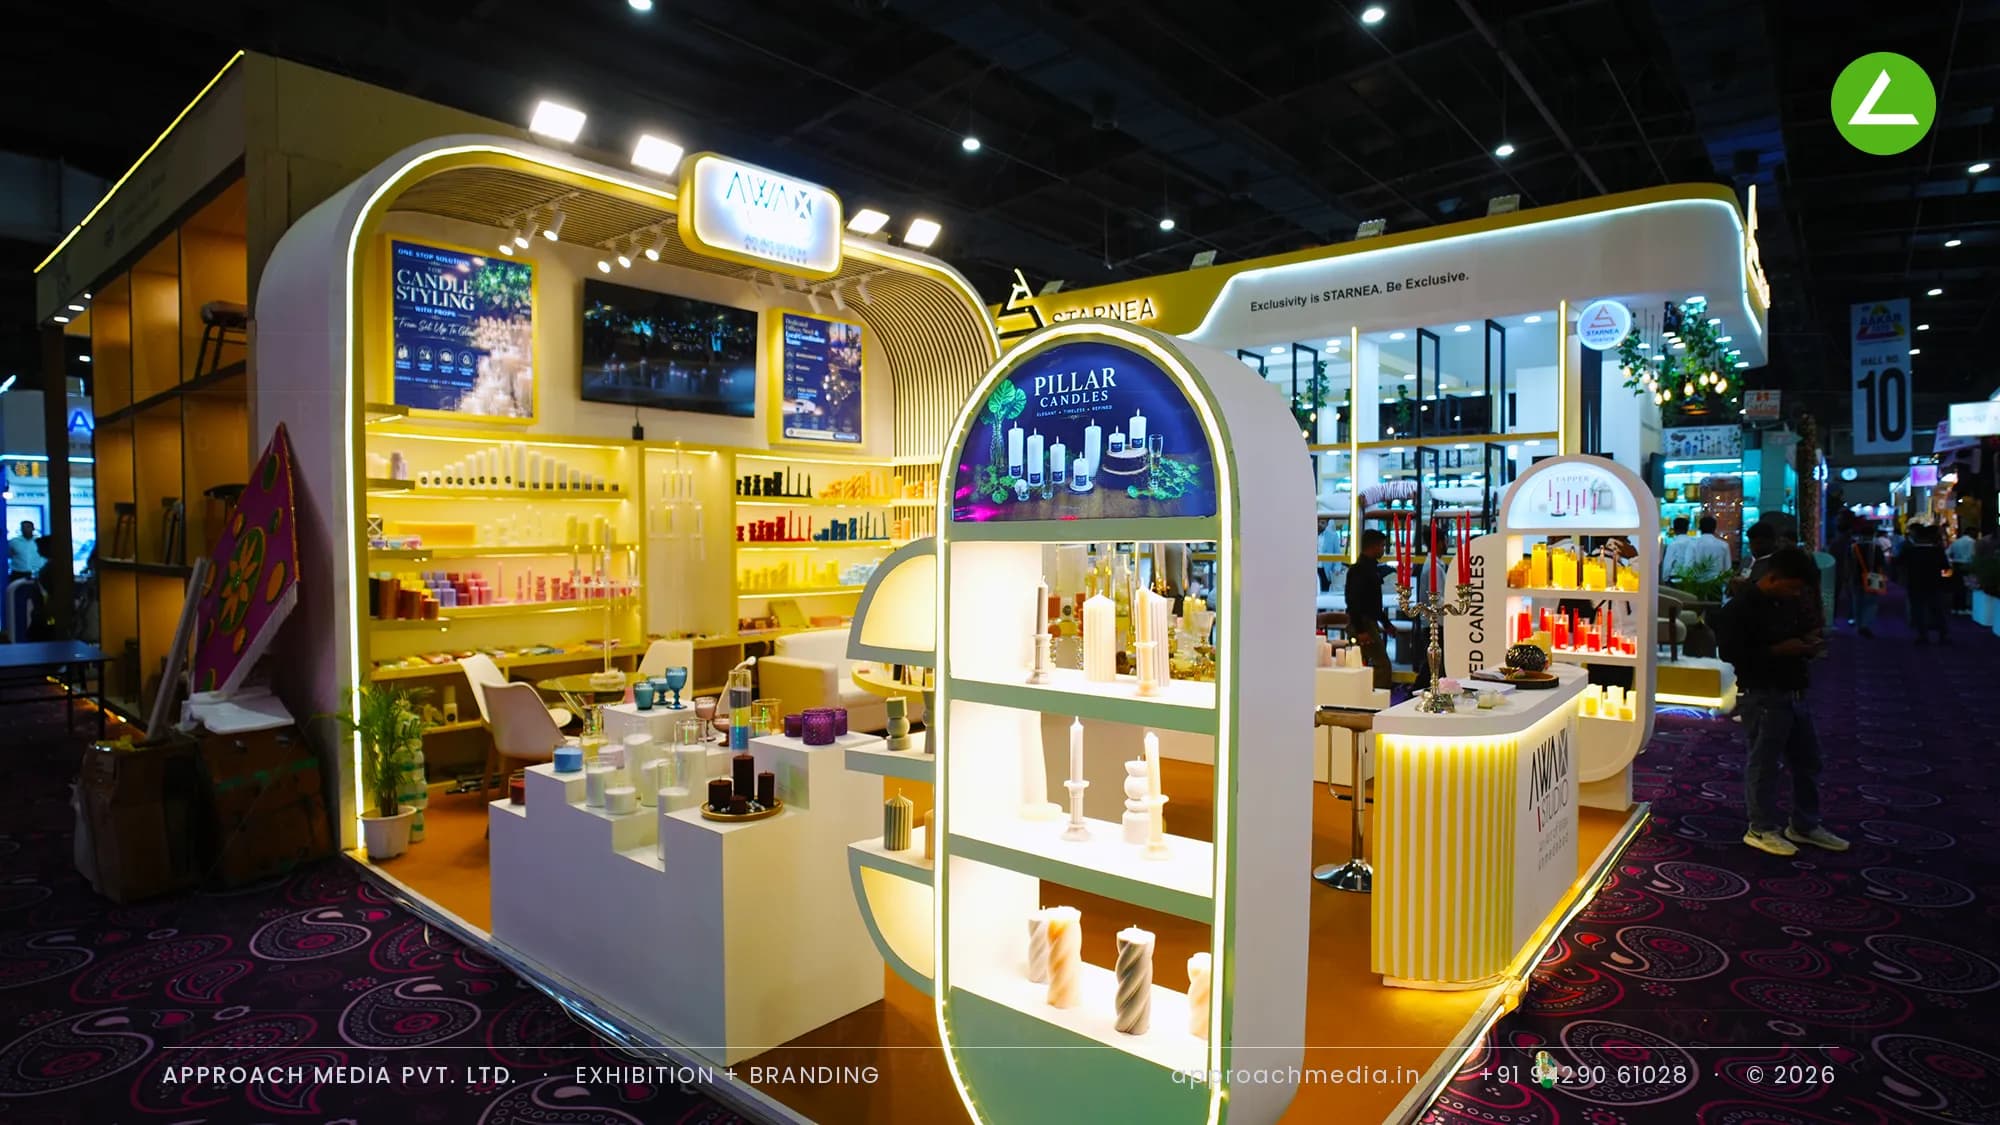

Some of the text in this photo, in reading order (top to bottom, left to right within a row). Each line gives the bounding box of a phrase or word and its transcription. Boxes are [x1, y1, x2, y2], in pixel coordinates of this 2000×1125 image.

[398, 248, 413, 257] ONE
[415, 251, 434, 260] STOP
[396, 268, 474, 296] CANDLE
[1250, 270, 1470, 312] Exclusivity is STARNEA. Be Exclusive.
[396, 285, 475, 311] STYLING
[415, 305, 456, 317] WITH PROPS
[1861, 355, 1883, 366] HALL
[1034, 367, 1117, 397] PILLAR
[1040, 390, 1108, 408] CANDLES
[1857, 368, 1907, 443] 10
[1469, 555, 1485, 643] CANDLES
